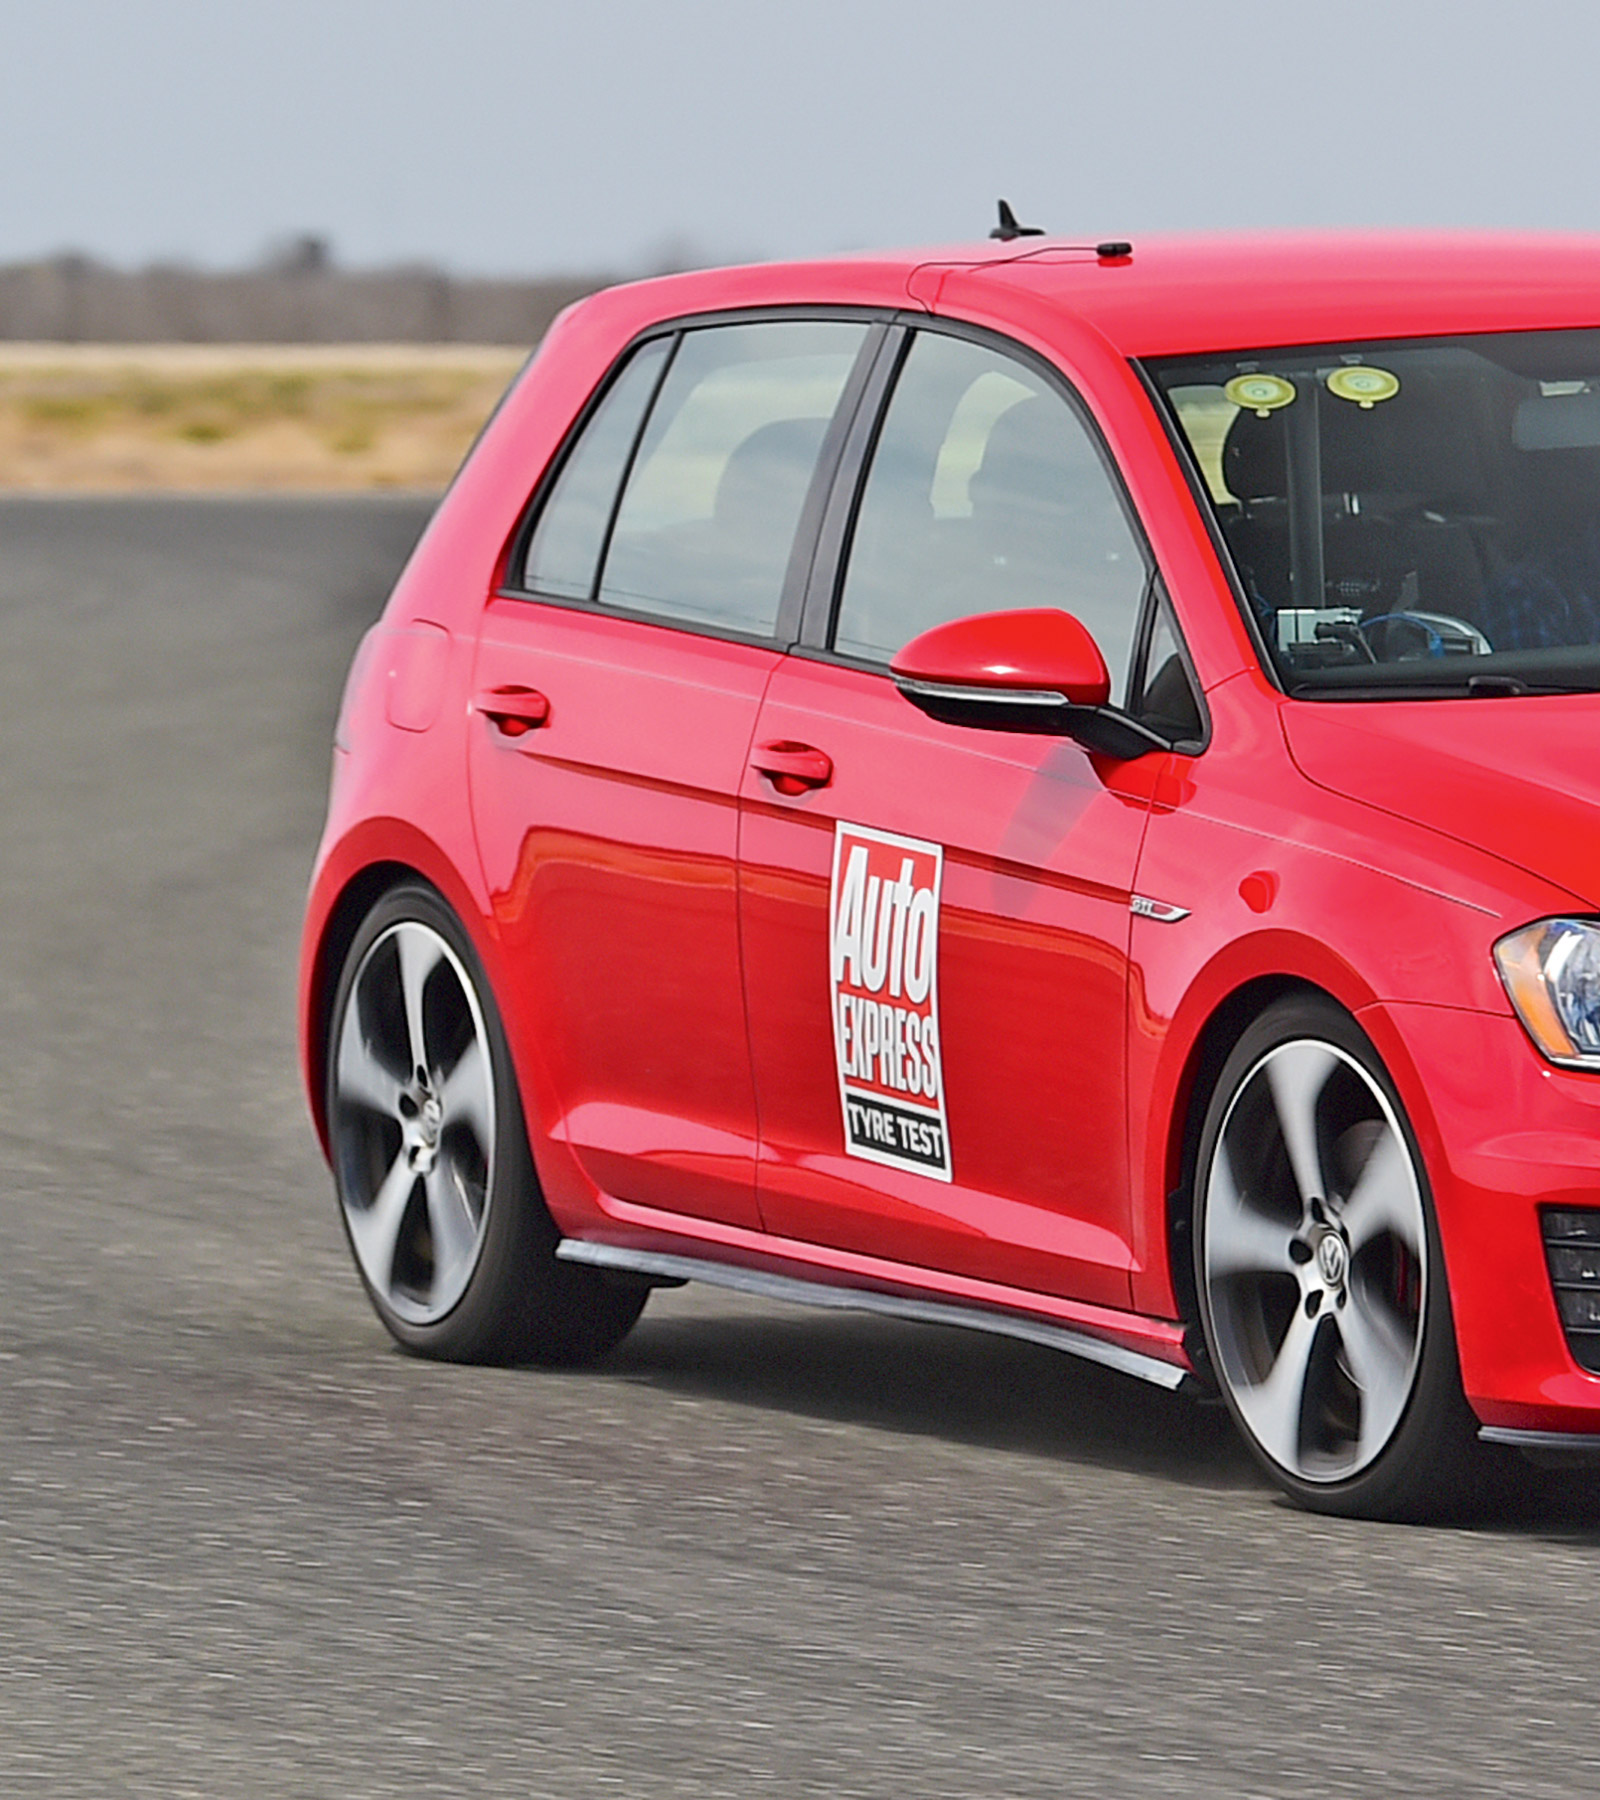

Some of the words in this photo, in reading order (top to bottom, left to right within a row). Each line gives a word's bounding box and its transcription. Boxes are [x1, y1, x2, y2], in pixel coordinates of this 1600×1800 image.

[836, 845, 934, 1003] Auto
[839, 992, 937, 1099] EXPRESS
[848, 1103, 897, 1139] TYRE
[897, 1111, 942, 1158] TEST
